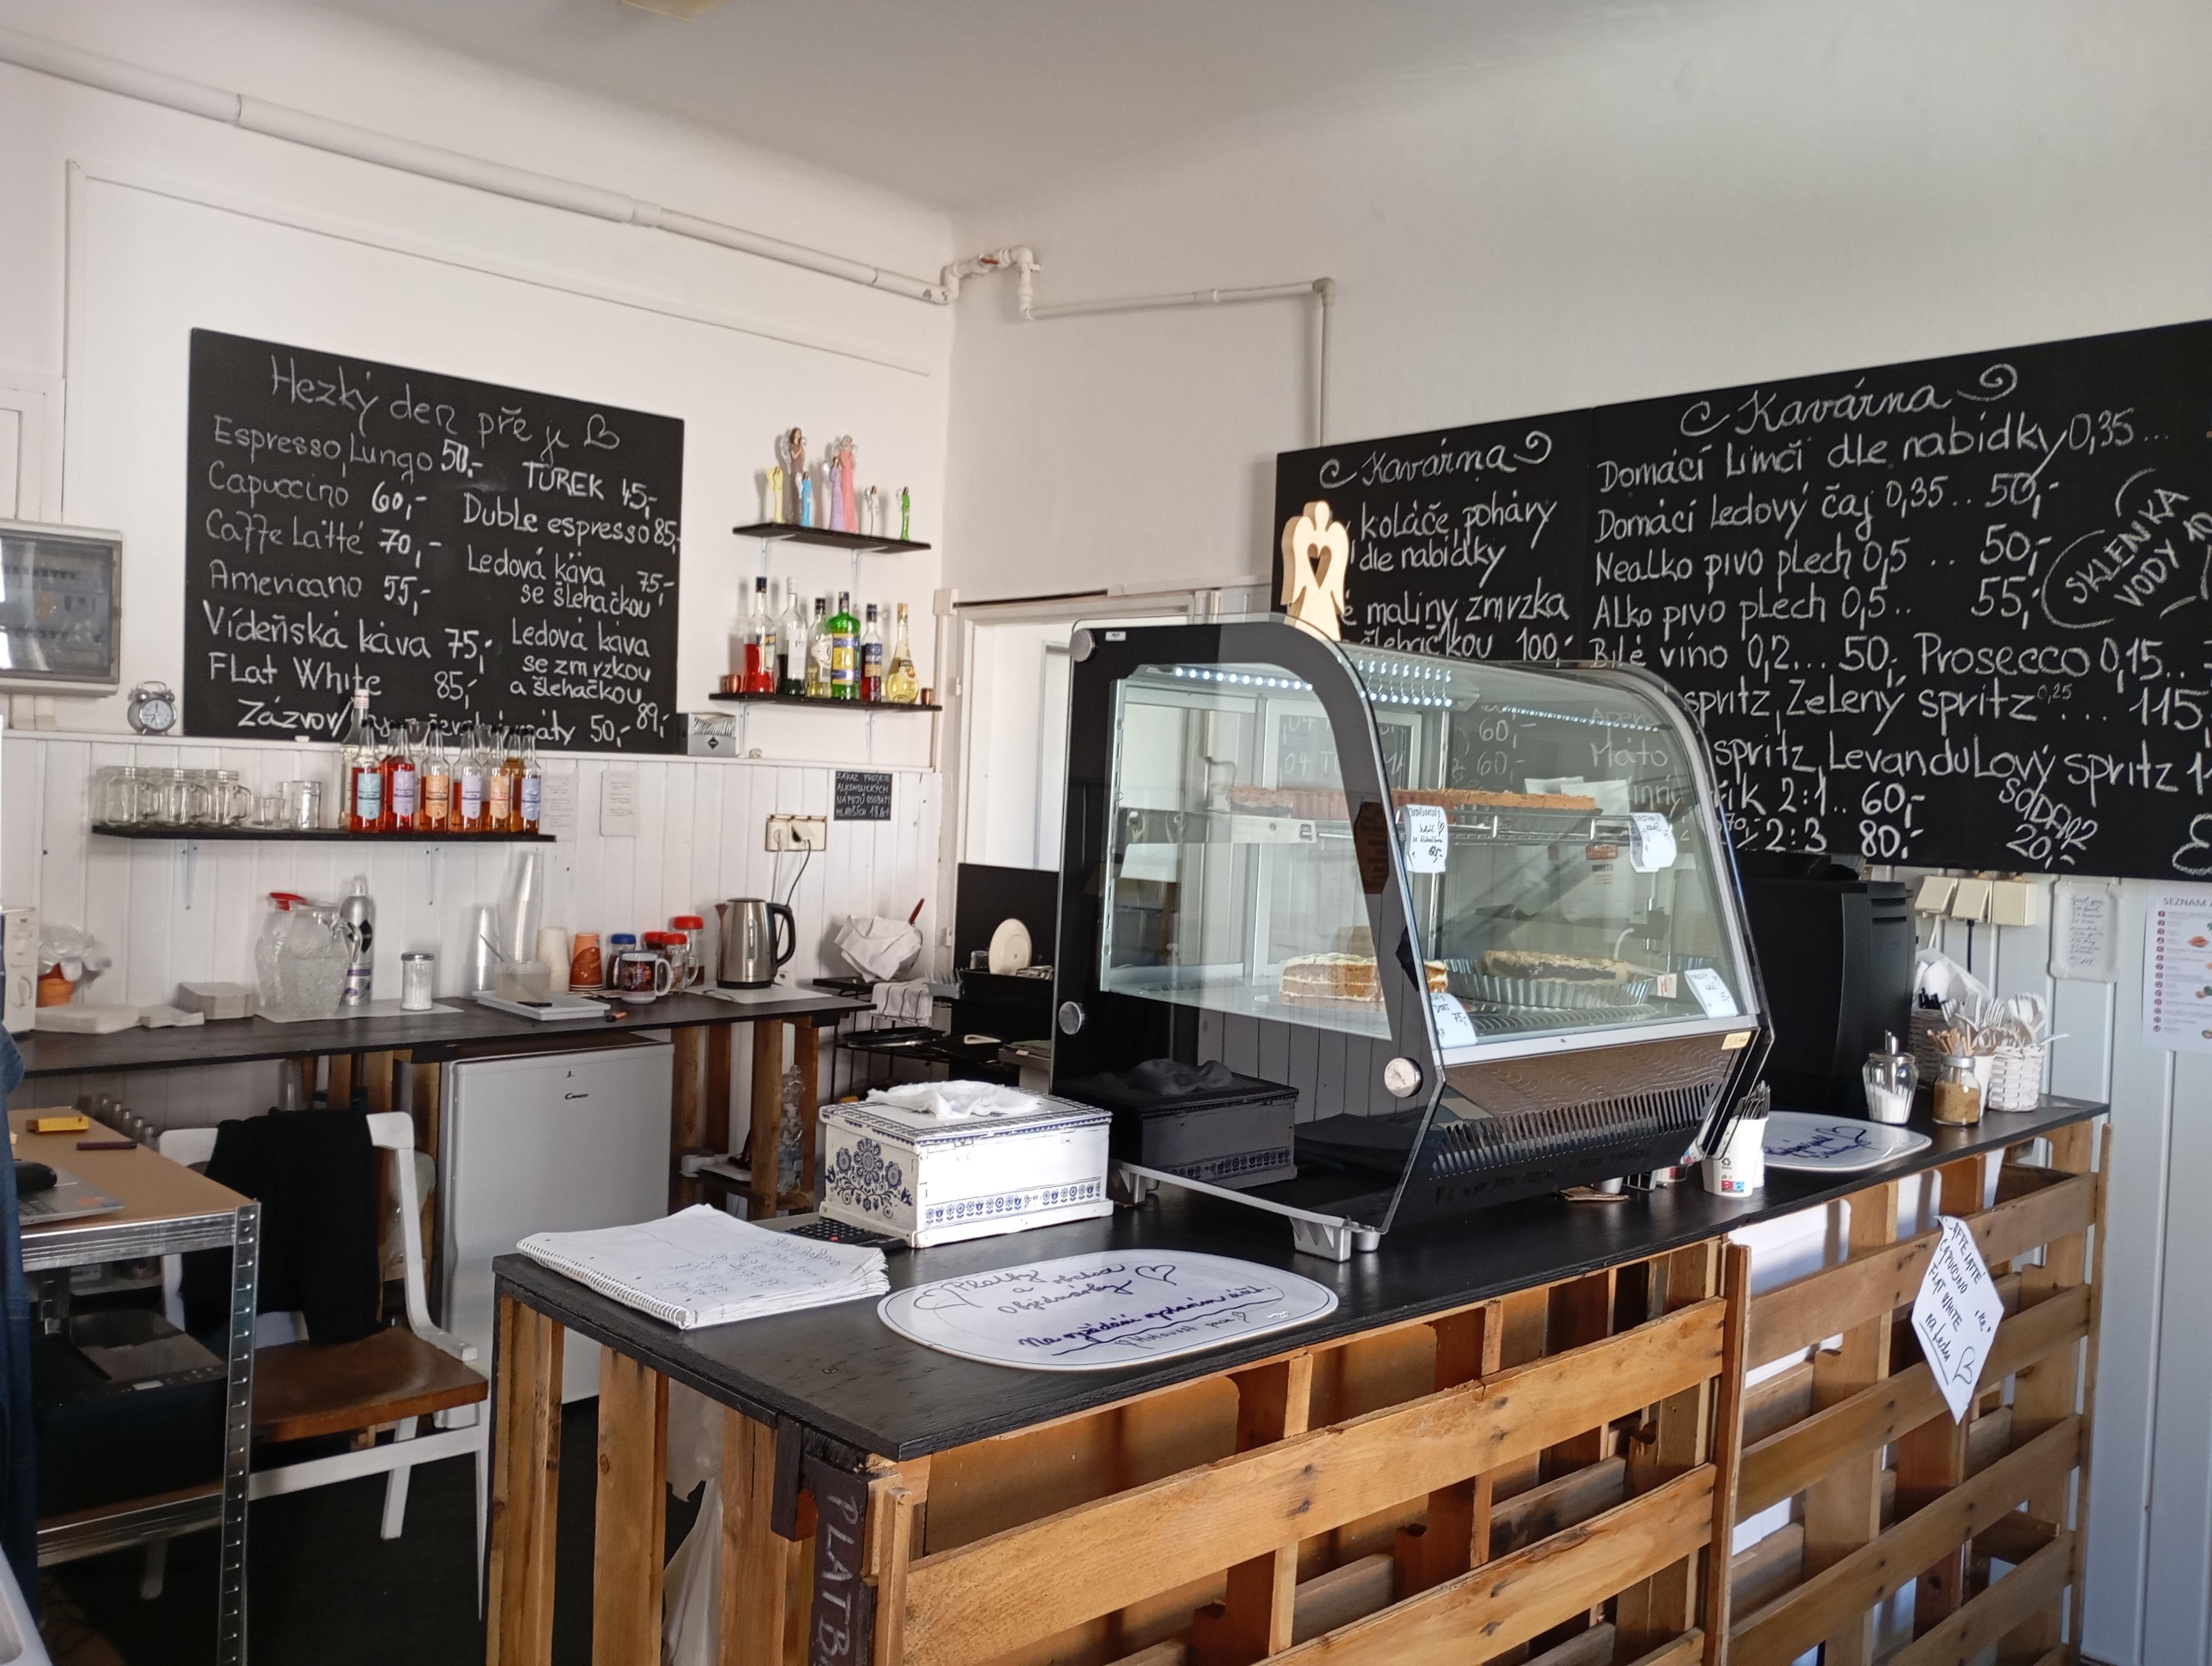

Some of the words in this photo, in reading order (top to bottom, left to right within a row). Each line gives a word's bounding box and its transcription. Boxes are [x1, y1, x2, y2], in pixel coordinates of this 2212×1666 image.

[272, 354, 379, 438] Hezký
[390, 383, 458, 435] den
[350, 431, 433, 484] Lungo
[1597, 445, 1712, 493] Domácí
[1827, 433, 1887, 468] dle
[1904, 411, 2068, 491] nabídky
[209, 460, 349, 508] Capuccino
[522, 461, 605, 500] TUREK
[547, 518, 649, 546] espresso
[1595, 499, 1697, 544] Domácí
[1822, 483, 1874, 541] čaj
[209, 559, 363, 598] Americano
[468, 544, 546, 580] Ledová
[1360, 540, 1394, 571] dle
[1402, 536, 1507, 589] nabídky
[1596, 548, 1693, 586] Nealko
[1705, 548, 1763, 594] pivo
[1778, 532, 1853, 593] plech
[2114, 538, 2179, 606] VODY
[520, 584, 544, 605] se
[1367, 590, 1458, 640] maliny
[1465, 577, 1570, 623] zmrzka
[1593, 594, 1652, 629] Alko
[1663, 600, 1726, 642] pivo
[1740, 582, 1826, 642] plech
[360, 618, 432, 659] káva
[1660, 631, 1728, 668] víno
[1913, 632, 2090, 677] Prosecco
[293, 656, 383, 695] White
[510, 680, 527, 696] a
[522, 655, 548, 673] se
[1786, 674, 1906, 736] Zelený
[1918, 677, 2038, 736] spritz
[1591, 736, 1668, 767] Máto
[2064, 739, 2179, 807] spritz
[2163, 896, 2206, 907] SEZNAM
[816, 1494, 859, 1666] PLATB
